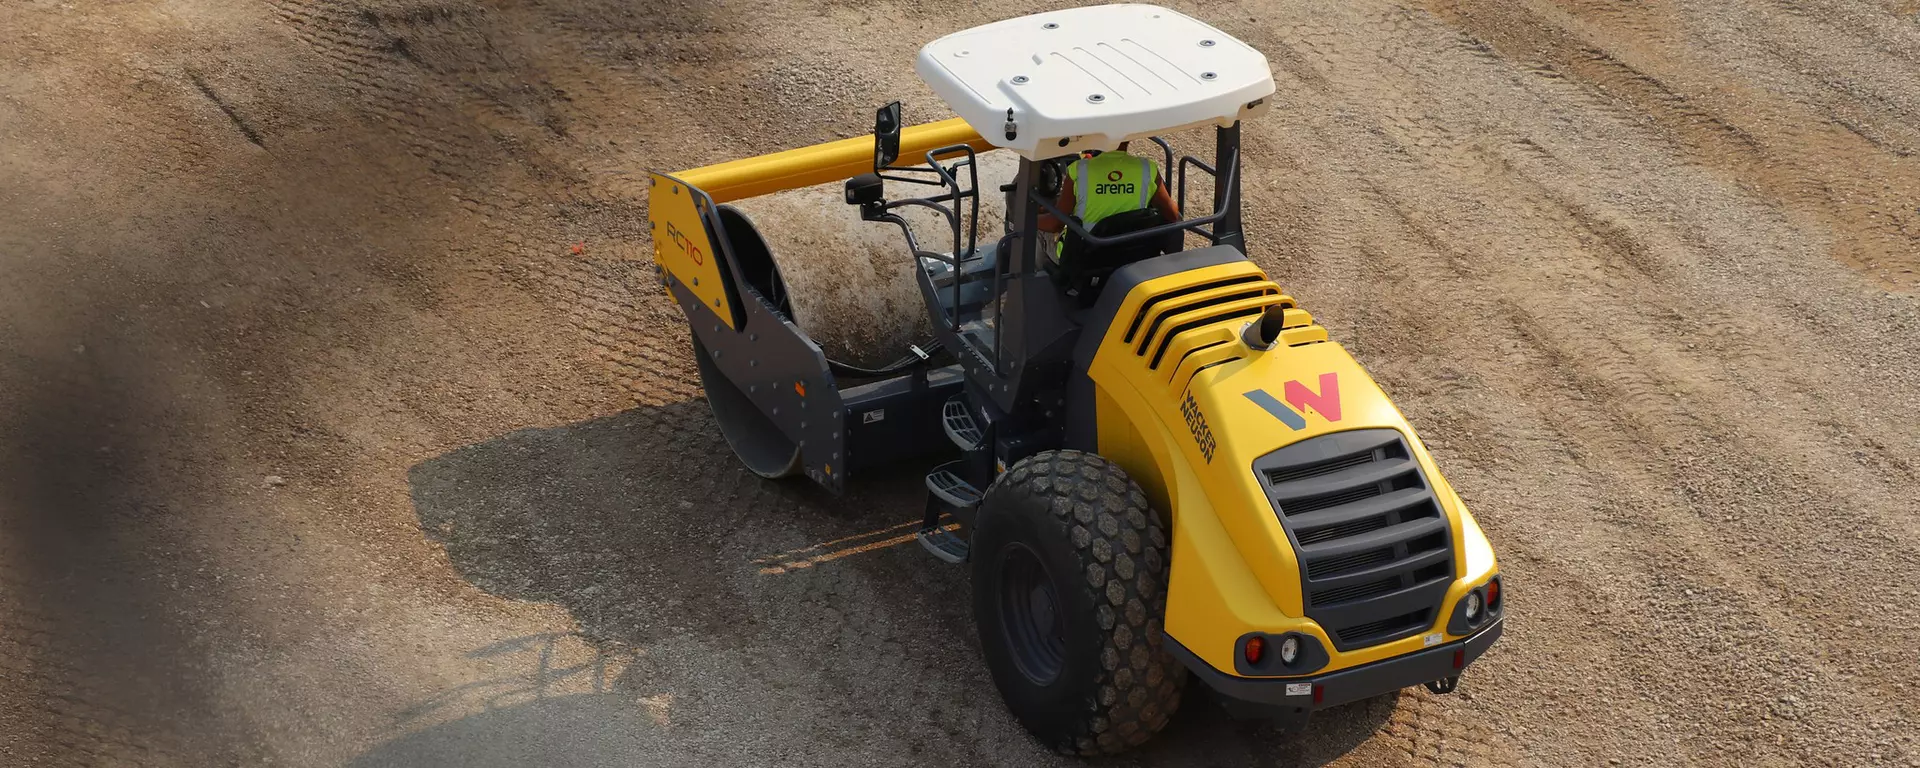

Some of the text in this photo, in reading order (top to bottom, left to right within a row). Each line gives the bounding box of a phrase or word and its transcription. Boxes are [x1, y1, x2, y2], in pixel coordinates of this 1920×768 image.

[1095, 183, 1135, 195] arena
[667, 221, 703, 266] RC110
[1180, 400, 1213, 465] NEUSON
[1187, 389, 1216, 454] WACKER
